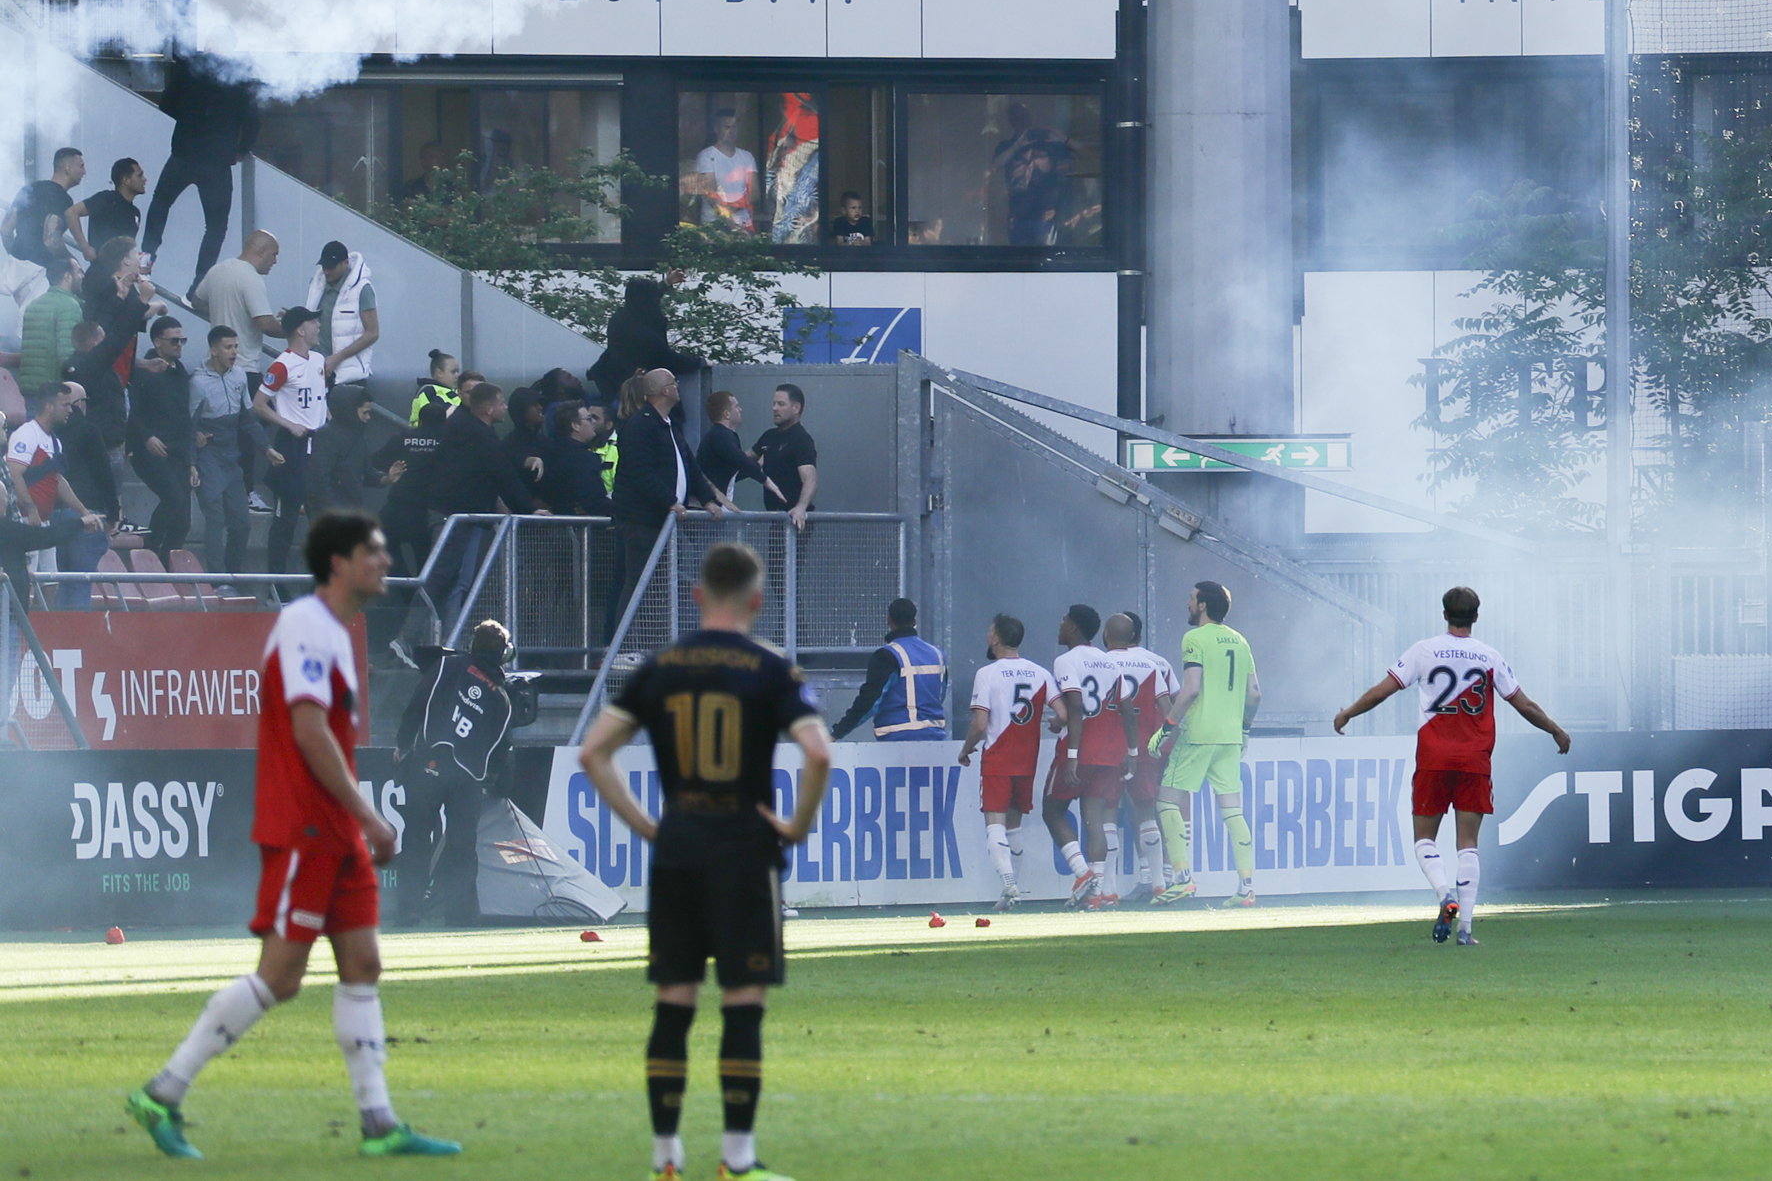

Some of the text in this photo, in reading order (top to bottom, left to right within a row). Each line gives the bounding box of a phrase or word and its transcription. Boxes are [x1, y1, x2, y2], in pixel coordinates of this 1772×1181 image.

[1226, 649, 1235, 691] 1
[1433, 650, 1488, 663] VESTERLUND
[121, 670, 262, 716] INFRAWER
[1010, 683, 1034, 725] 5
[1425, 665, 1487, 715] 23
[664, 692, 743, 782] 10
[70, 781, 216, 860] DASSY
[103, 872, 190, 893] FITS THE JOB
[381, 869, 398, 888] TH
